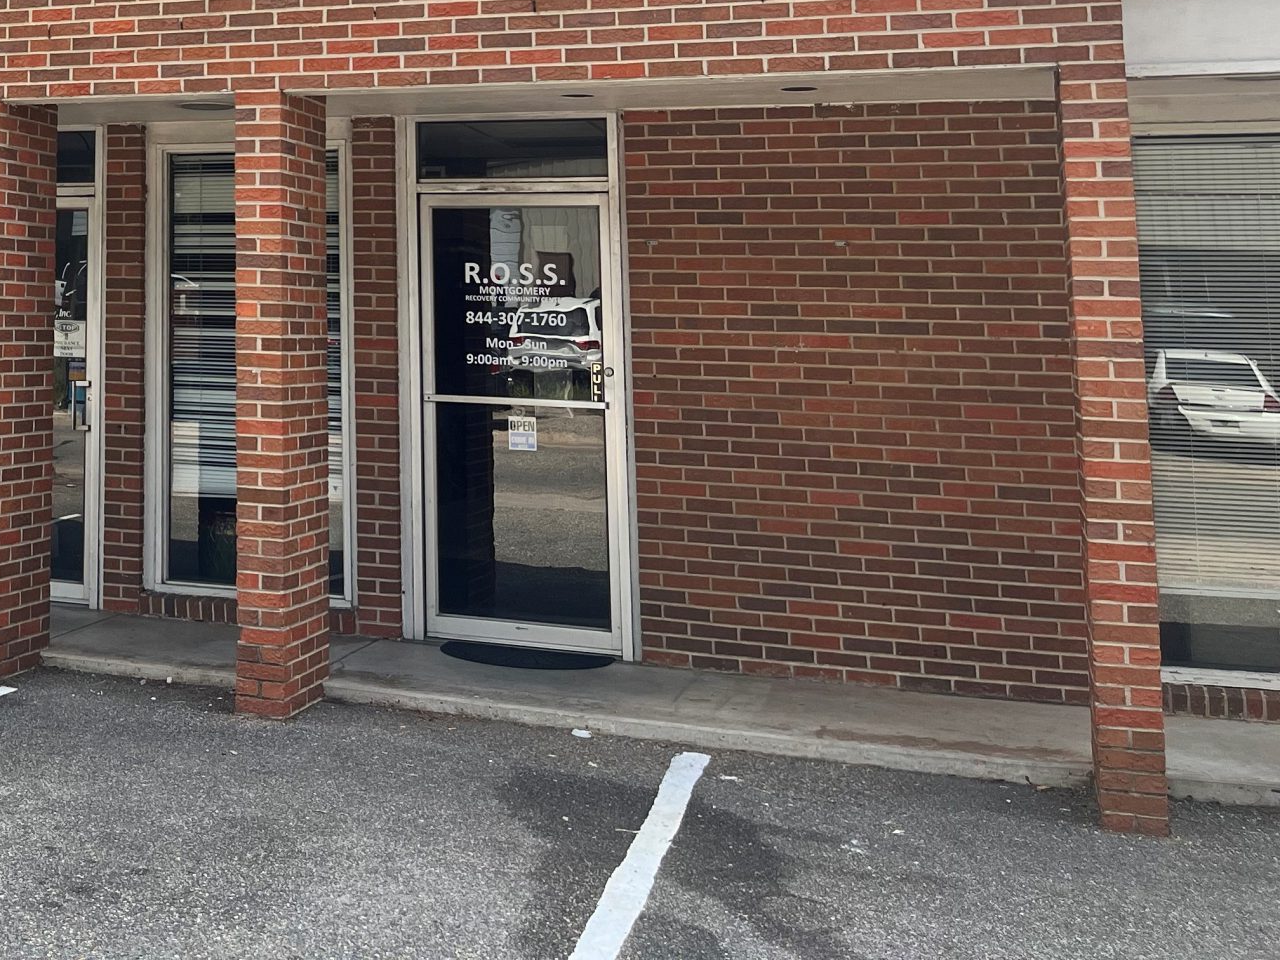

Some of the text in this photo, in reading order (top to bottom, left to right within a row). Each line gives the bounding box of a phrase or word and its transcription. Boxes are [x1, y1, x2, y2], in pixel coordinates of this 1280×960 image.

[464, 262, 566, 286] R.O.S.S.
[479, 286, 551, 296] MONTGOMERY
[498, 295, 540, 303] COMMUNITY
[465, 311, 567, 327] 844-307-1760
[485, 337, 514, 349] Mon
[524, 339, 548, 350] Sun
[466, 353, 510, 366] 9:00am
[521, 355, 568, 369] 9:00pm
[510, 420, 535, 432] OPEN
